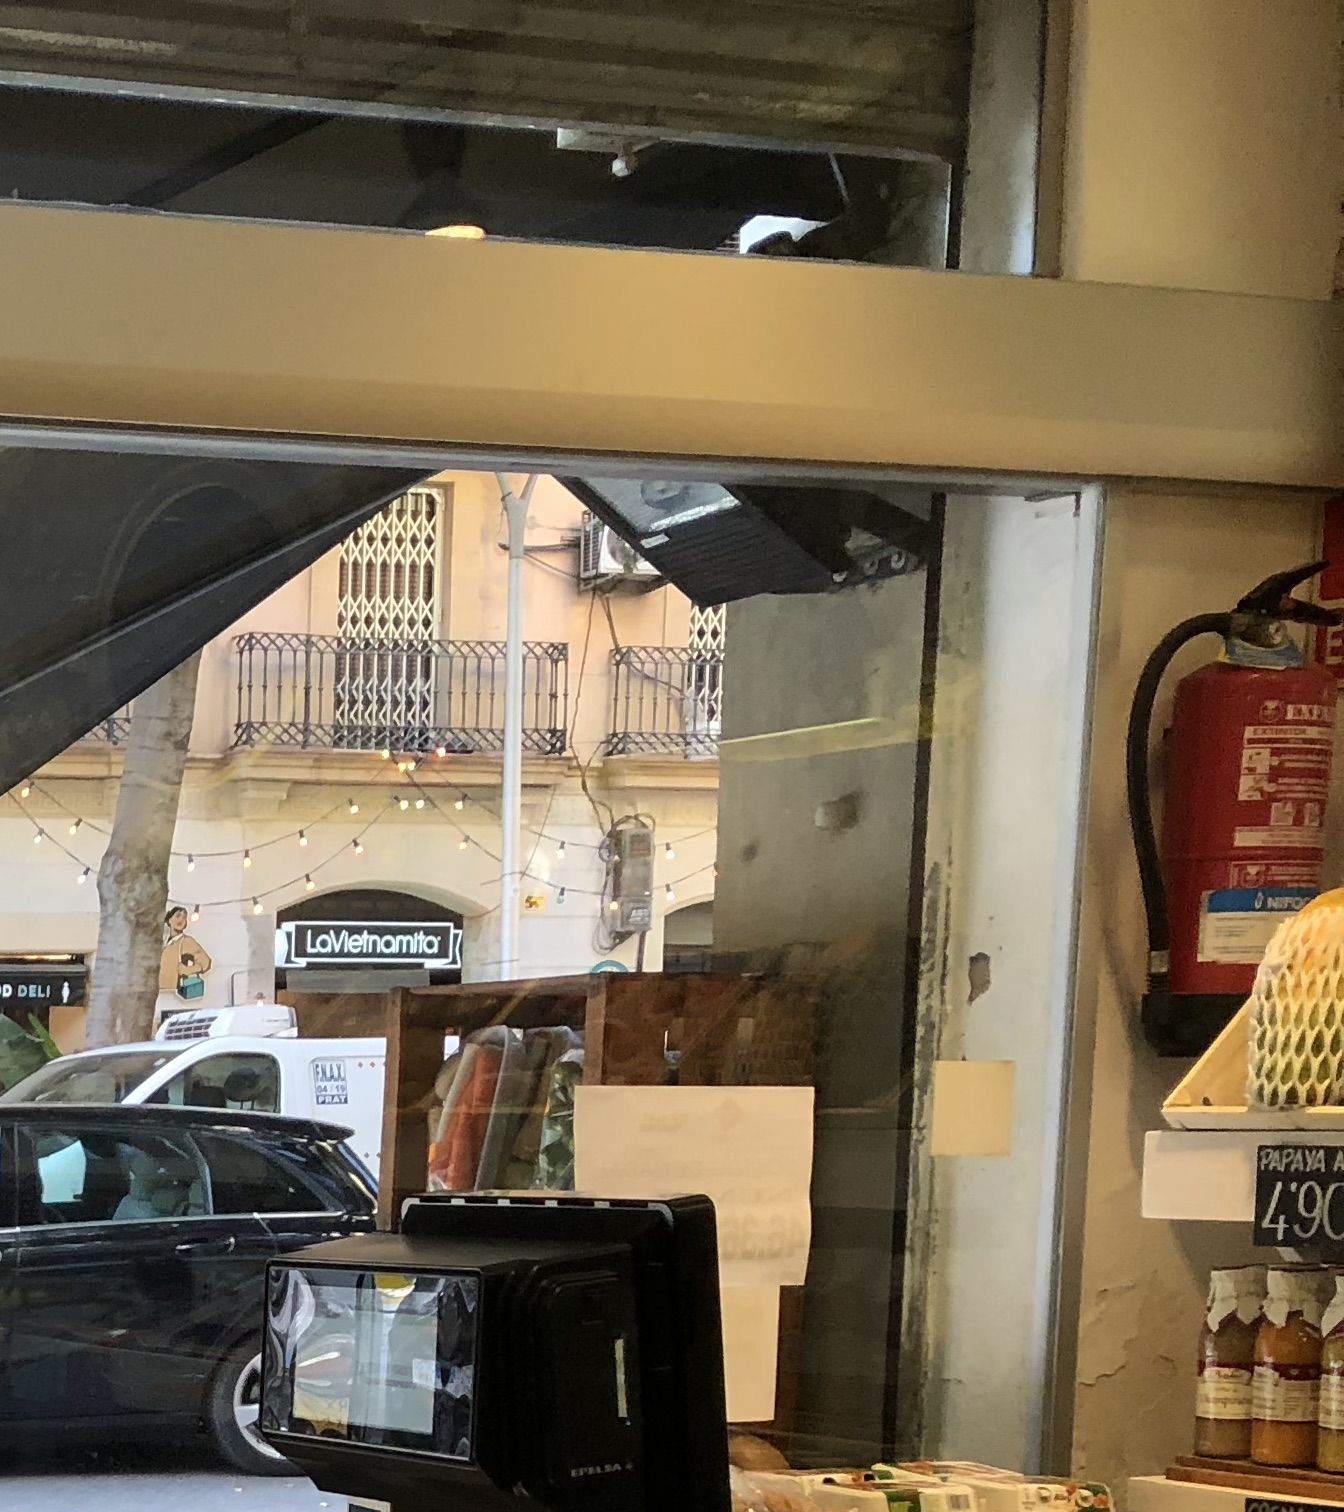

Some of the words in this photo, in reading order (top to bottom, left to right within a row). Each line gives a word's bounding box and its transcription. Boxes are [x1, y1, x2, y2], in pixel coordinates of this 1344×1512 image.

[306, 928, 442, 954] LaVietnamita
[17, 986, 51, 998] DELI
[317, 1095, 347, 1103] PRAT
[1260, 1149, 1326, 1172] PAPAYA
